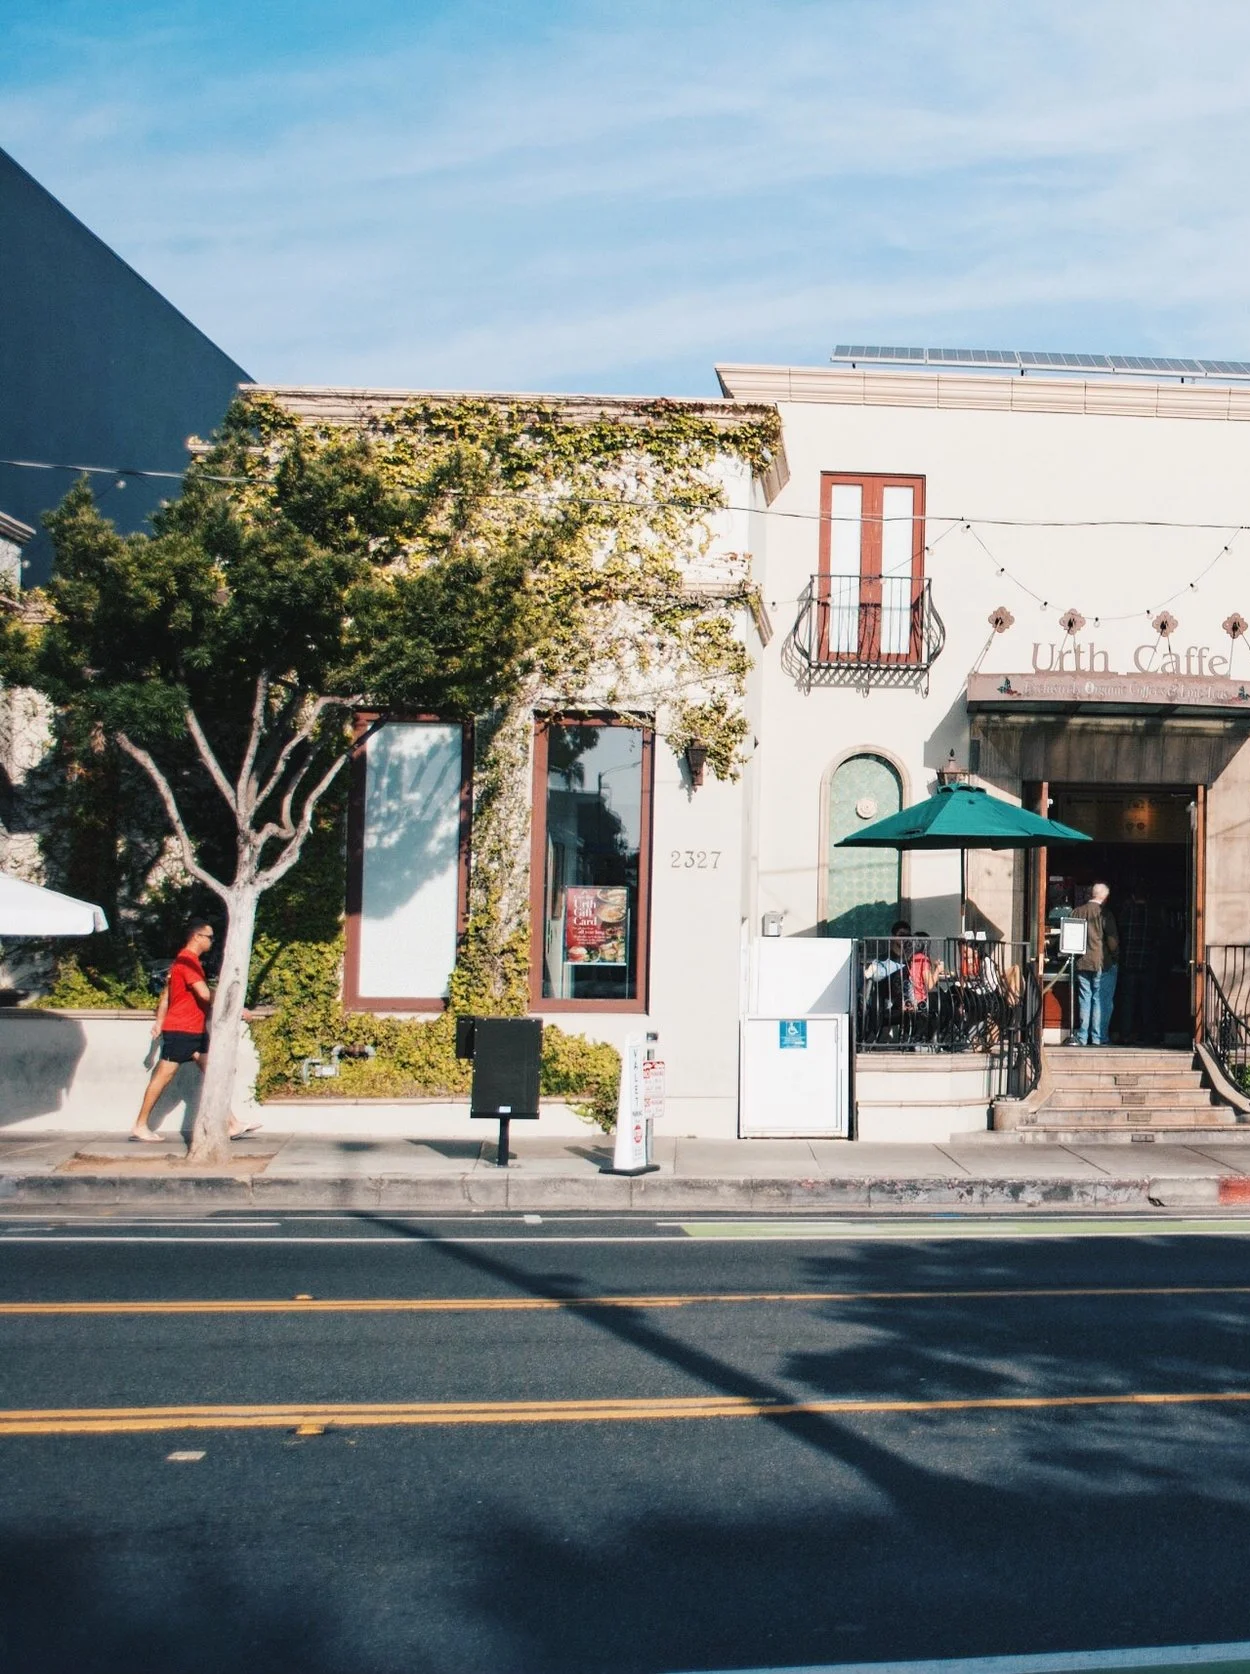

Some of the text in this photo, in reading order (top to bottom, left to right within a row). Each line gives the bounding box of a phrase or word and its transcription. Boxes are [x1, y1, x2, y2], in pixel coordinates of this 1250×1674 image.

[1031, 642, 1229, 679] Urth Caffe
[1085, 681, 1126, 698] Organic
[671, 850, 722, 869] 2327
[573, 899, 597, 909] Urth
[573, 917, 598, 926] Card
